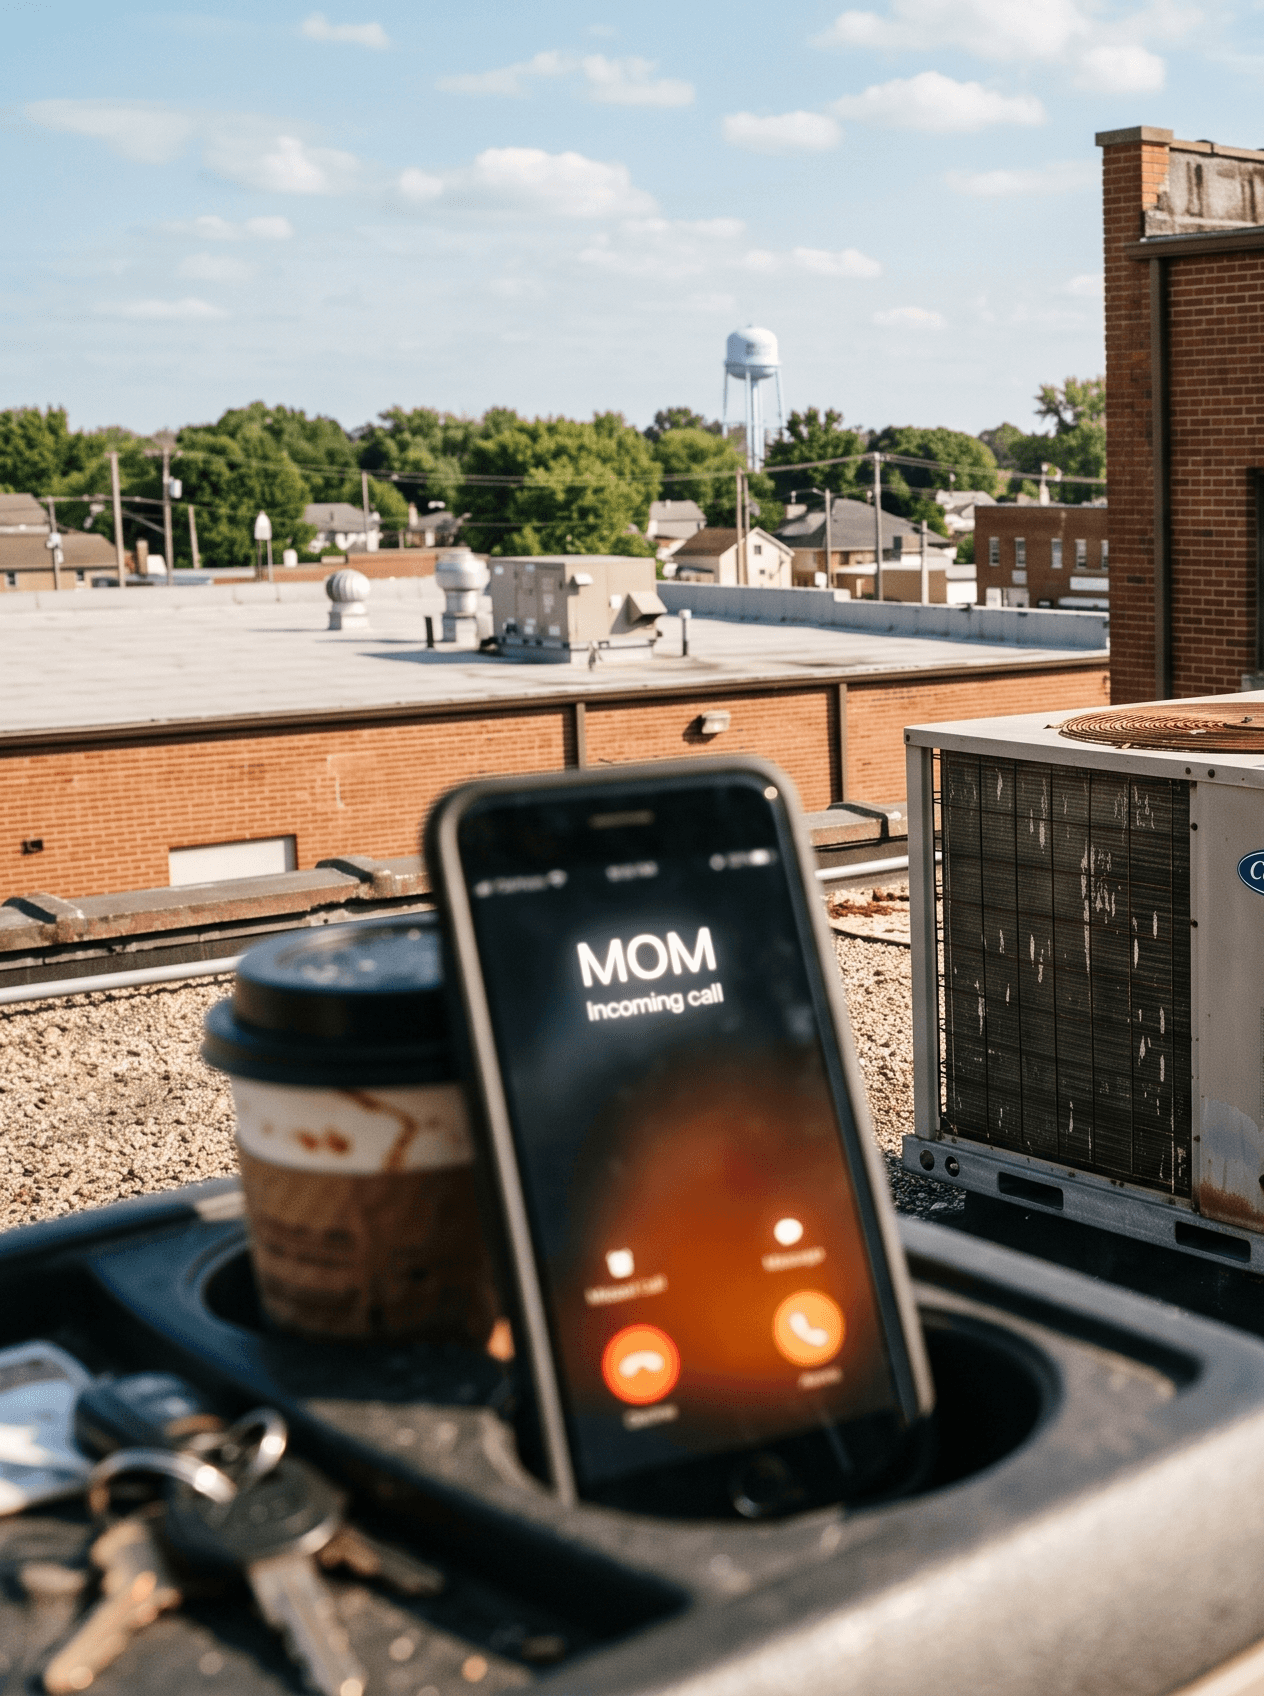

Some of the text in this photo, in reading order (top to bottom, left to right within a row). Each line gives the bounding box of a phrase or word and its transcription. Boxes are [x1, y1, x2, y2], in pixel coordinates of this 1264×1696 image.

[576, 926, 717, 988] MOM
[586, 982, 725, 1022] Incoming call
